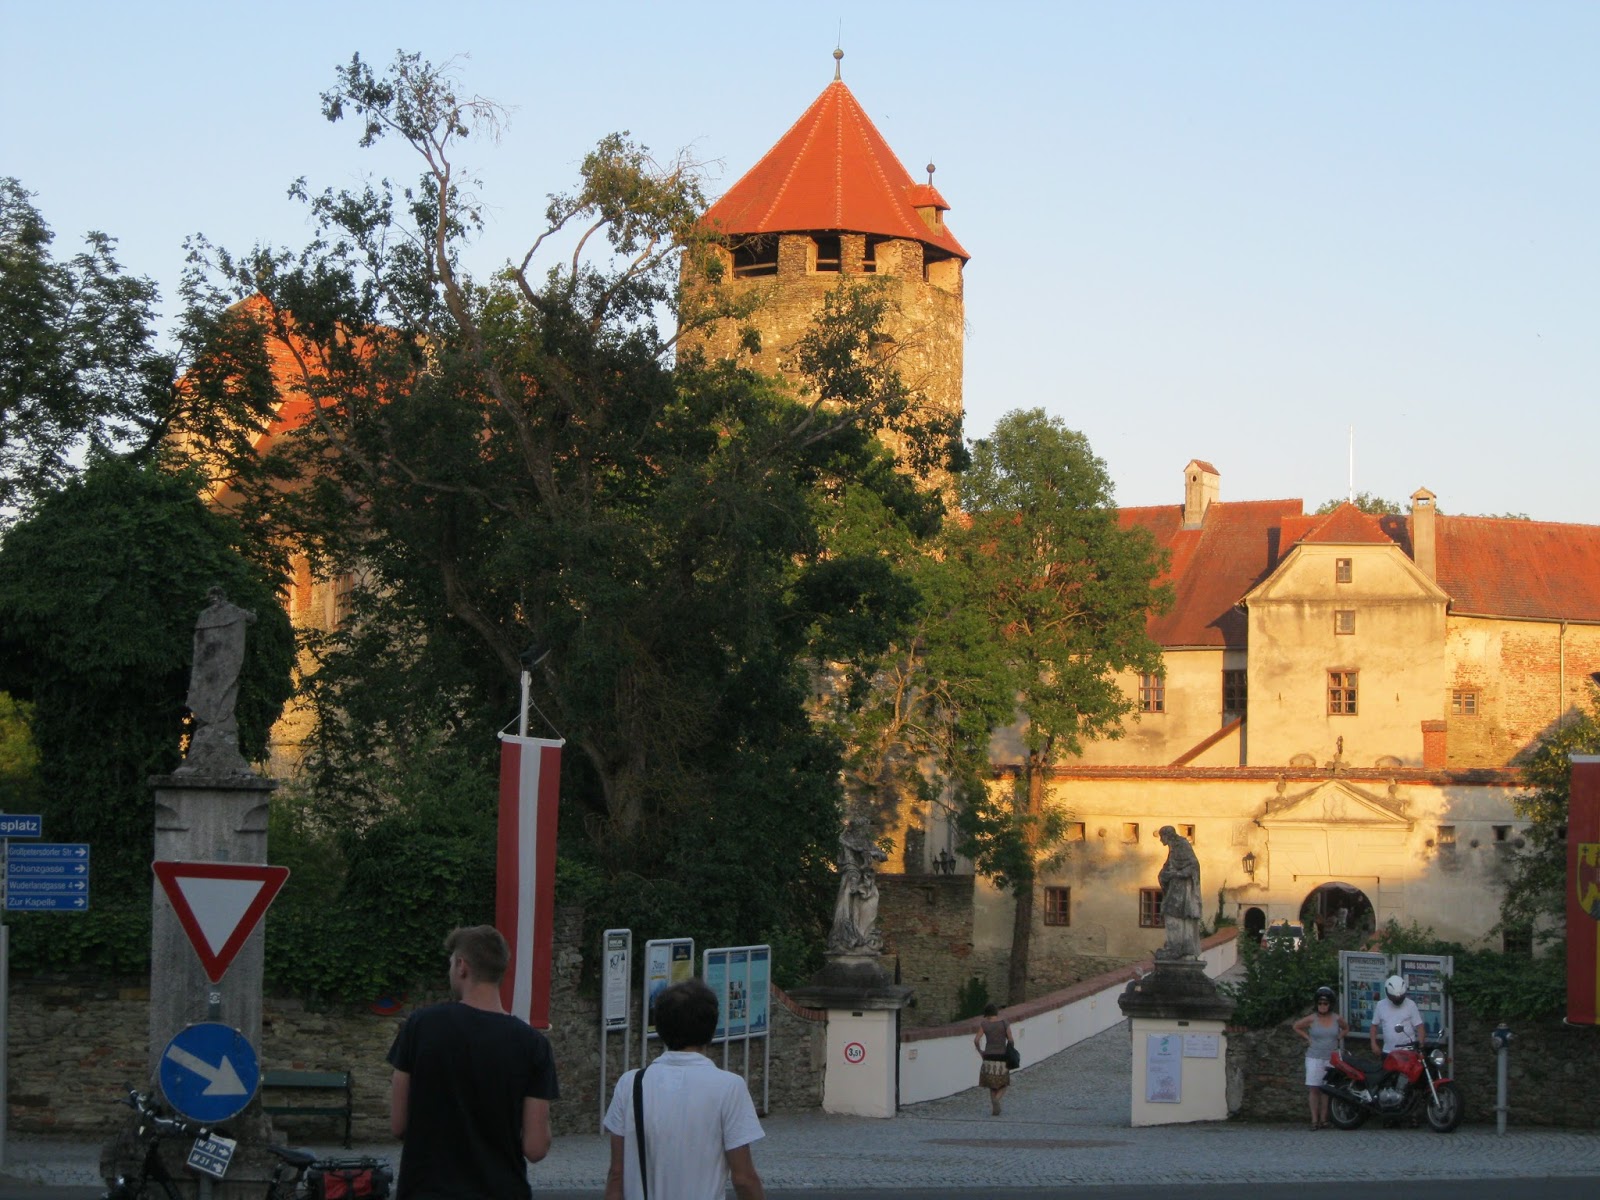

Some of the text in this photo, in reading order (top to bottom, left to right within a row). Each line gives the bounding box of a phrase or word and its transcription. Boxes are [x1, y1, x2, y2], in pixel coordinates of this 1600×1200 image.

[0, 820, 38, 832] splatz
[62, 847, 74, 857] Str.
[9, 864, 65, 874] Schanzgasse
[9, 898, 57, 908] Zur Kapelle
